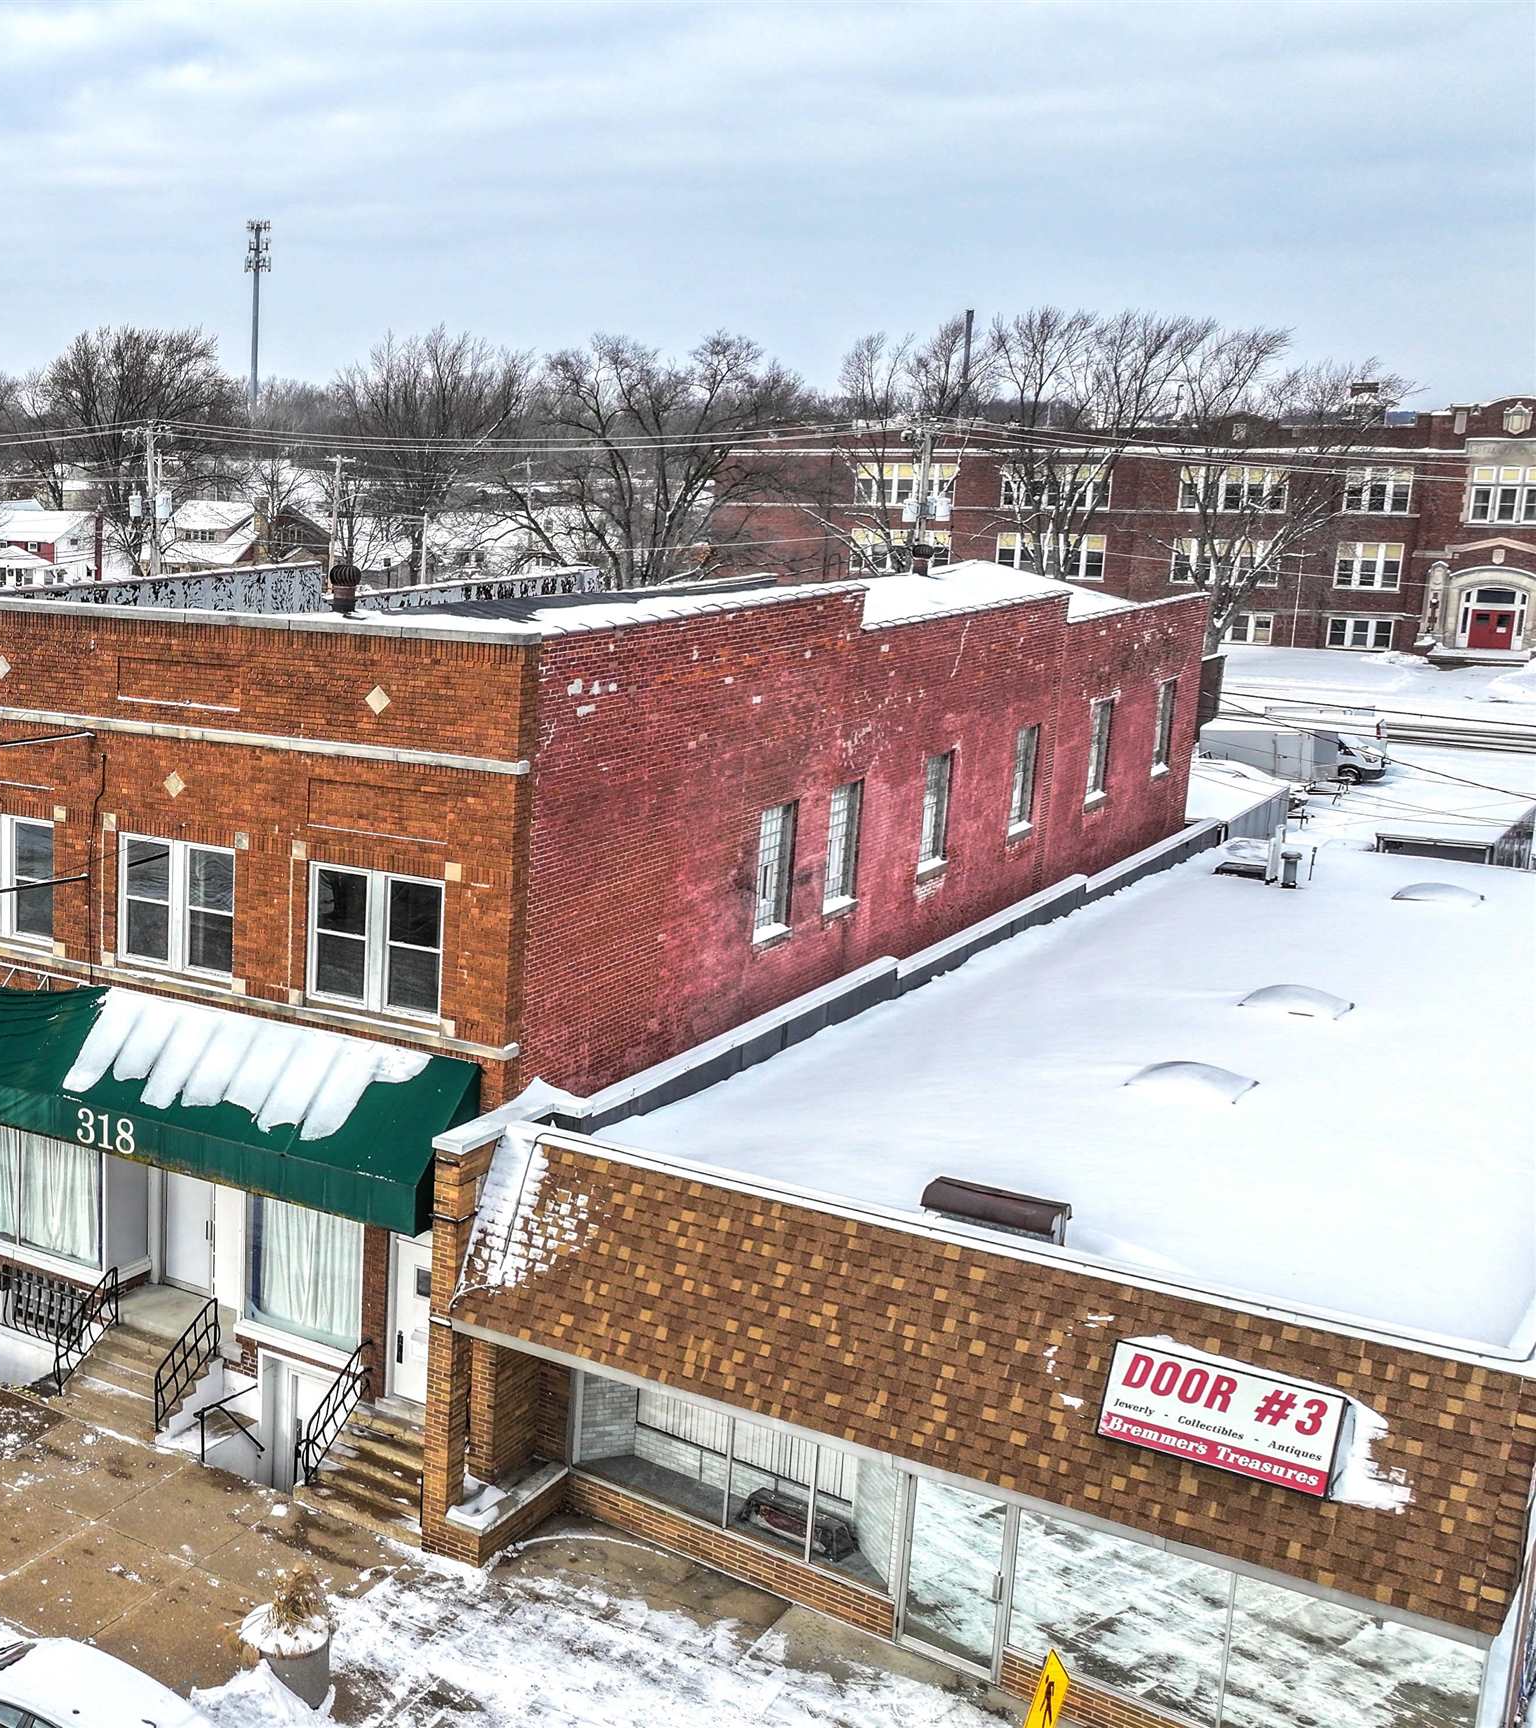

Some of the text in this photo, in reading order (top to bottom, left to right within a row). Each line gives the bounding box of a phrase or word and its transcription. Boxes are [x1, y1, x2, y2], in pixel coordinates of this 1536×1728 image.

[76, 1107, 135, 1154] 318
[1121, 1352, 1328, 1436] DOOR #3
[1113, 1398, 1156, 1417] Jewerly
[1177, 1415, 1244, 1441] Collectibles
[1268, 1440, 1322, 1462] Antiques
[1215, 1445, 1319, 1487] Treasures
